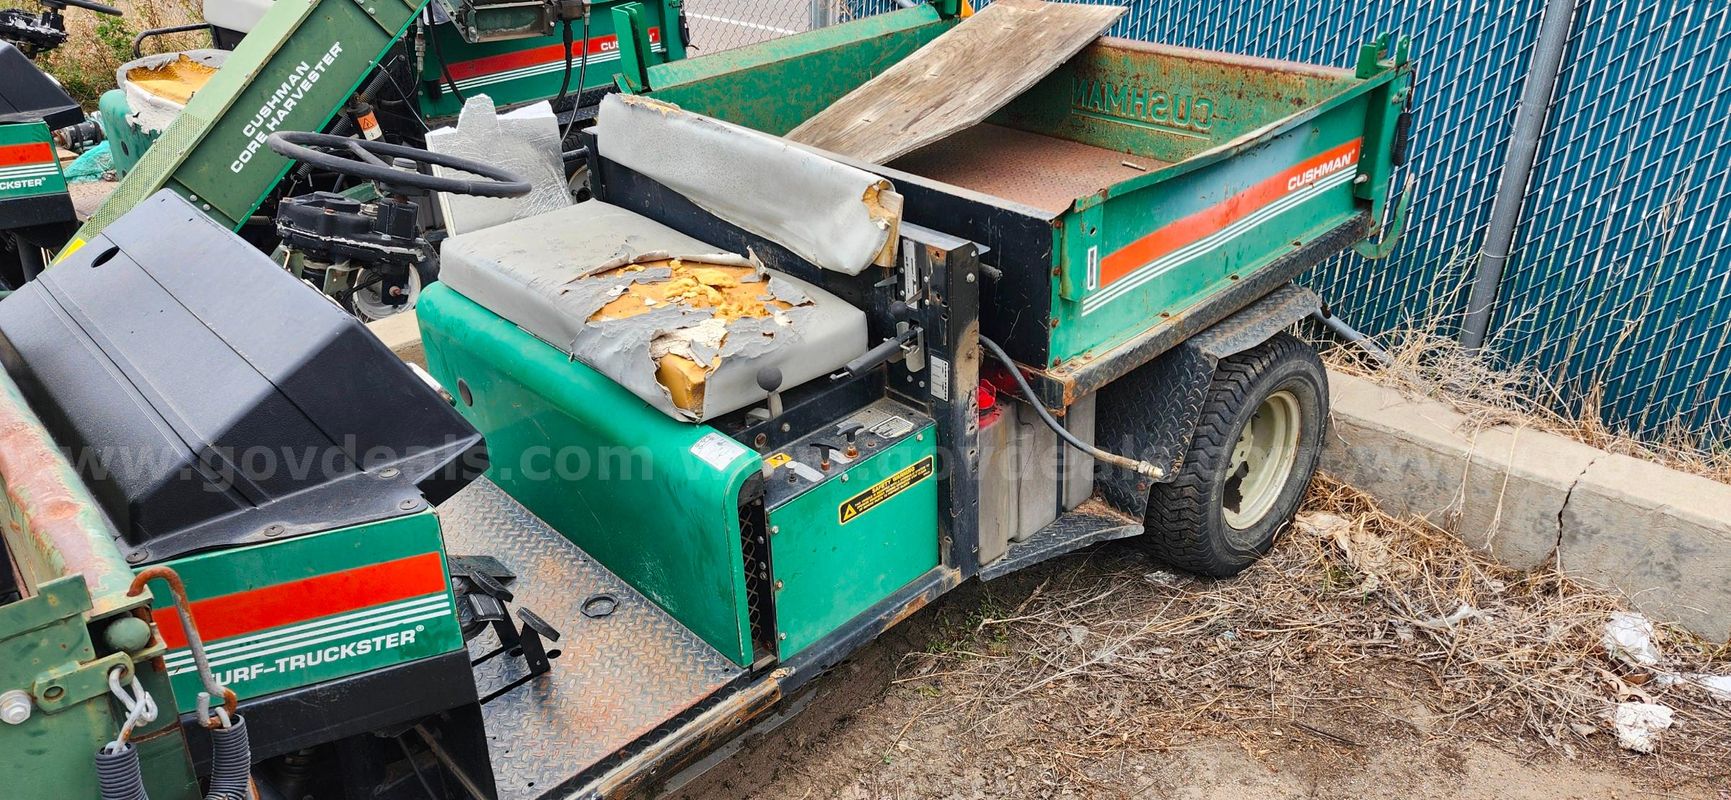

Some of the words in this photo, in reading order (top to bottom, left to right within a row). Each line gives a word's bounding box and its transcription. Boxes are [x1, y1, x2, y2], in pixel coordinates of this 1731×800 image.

[230, 131, 268, 173] CORE
[266, 41, 343, 131] HARVESTER
[242, 61, 310, 137] CUSHMAN
